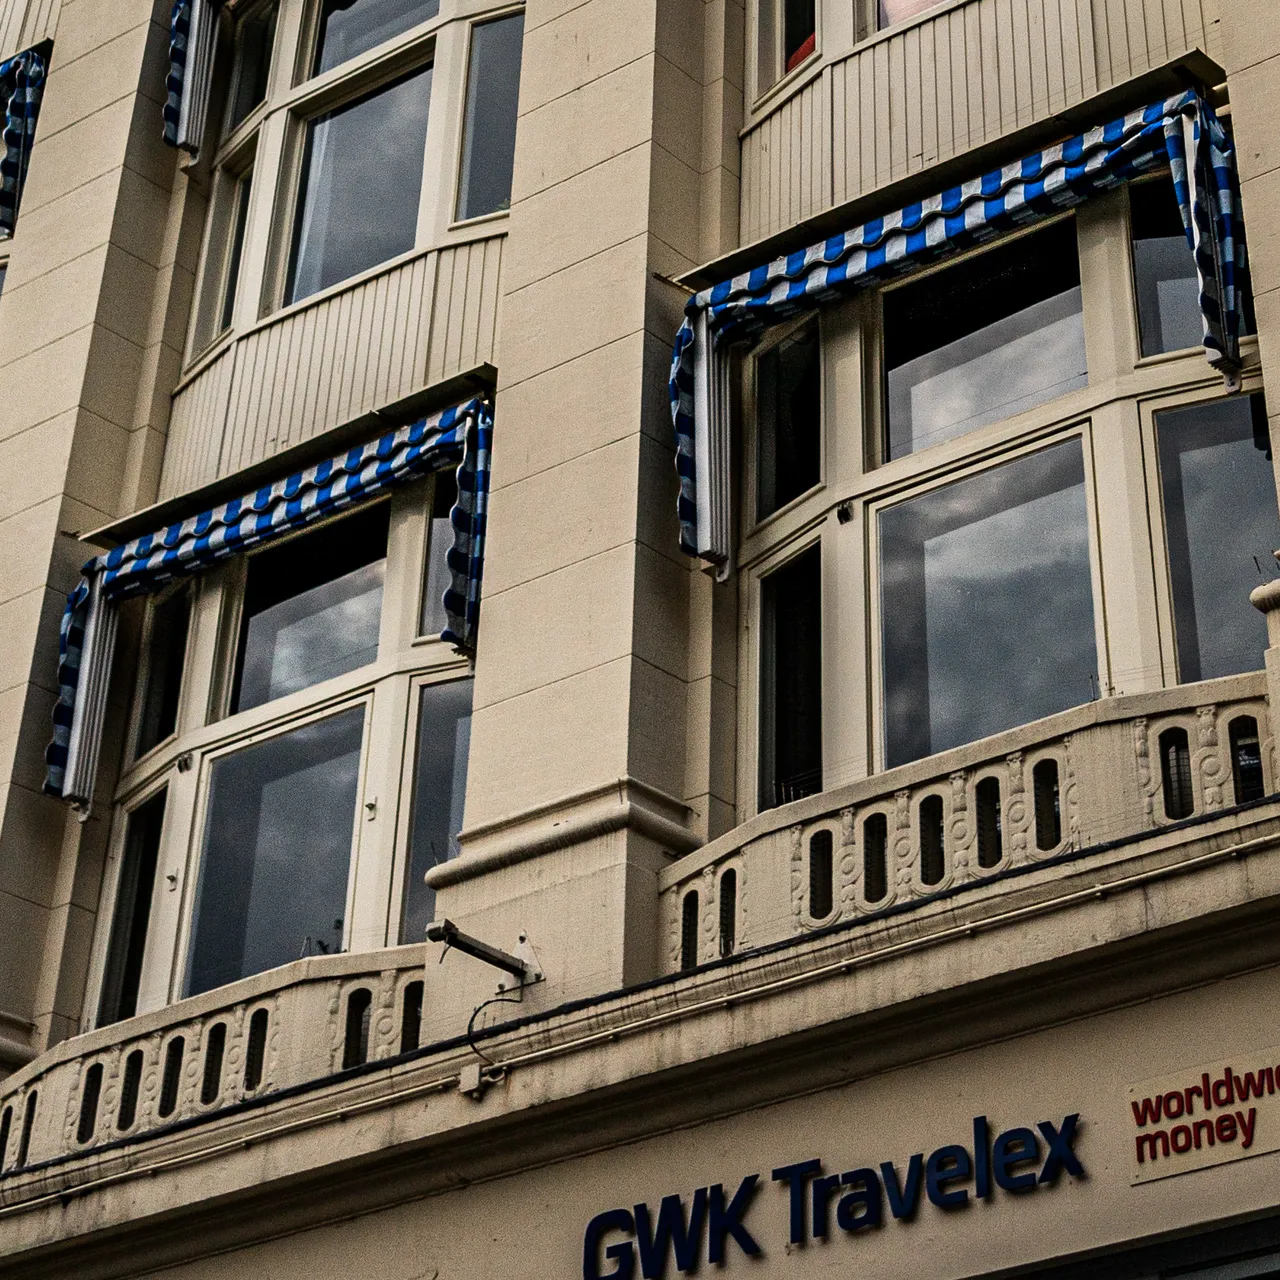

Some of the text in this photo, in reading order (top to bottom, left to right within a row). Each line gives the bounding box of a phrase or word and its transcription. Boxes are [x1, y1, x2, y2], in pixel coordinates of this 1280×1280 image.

[1135, 1107, 1257, 1164] money
[582, 1113, 1085, 1280] GWK Travelex
